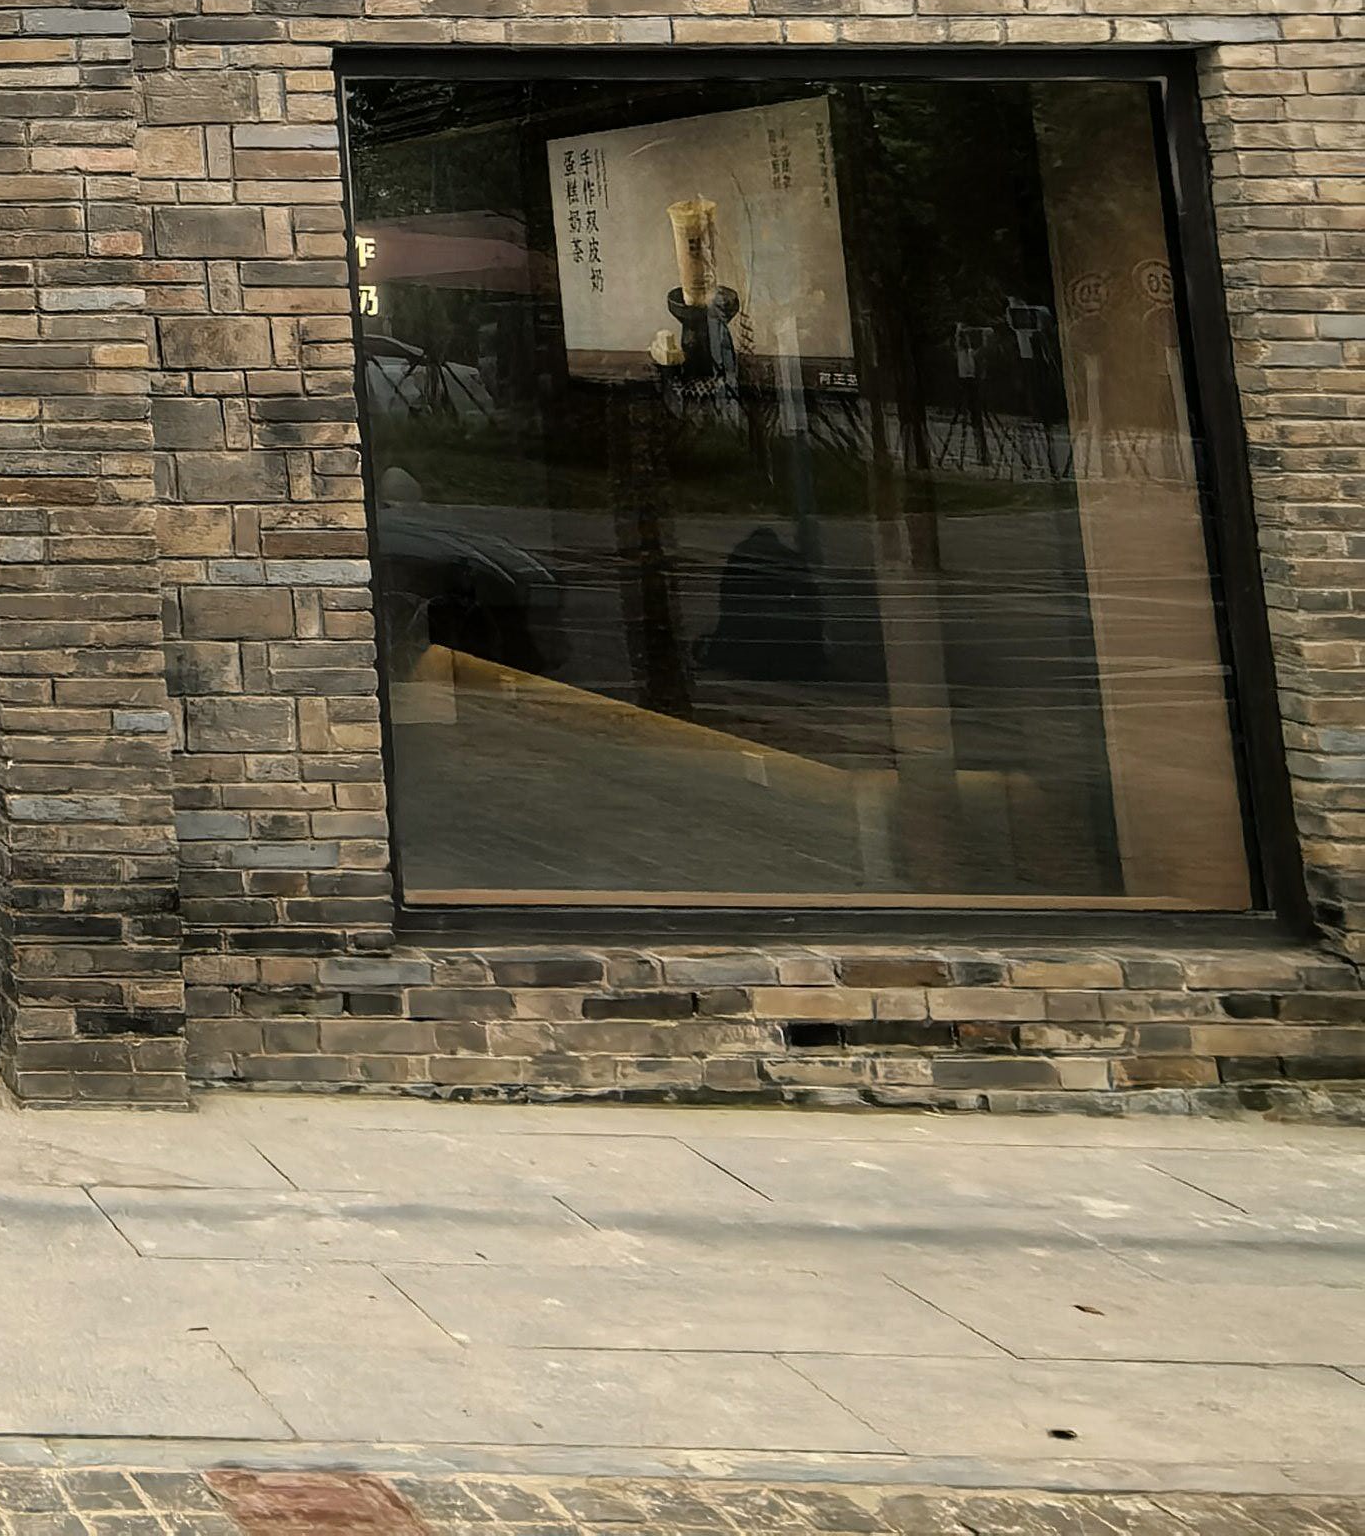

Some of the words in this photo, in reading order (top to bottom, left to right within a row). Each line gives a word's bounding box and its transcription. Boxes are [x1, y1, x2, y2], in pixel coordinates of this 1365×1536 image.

[580, 148, 604, 294] 手作双皮奶
